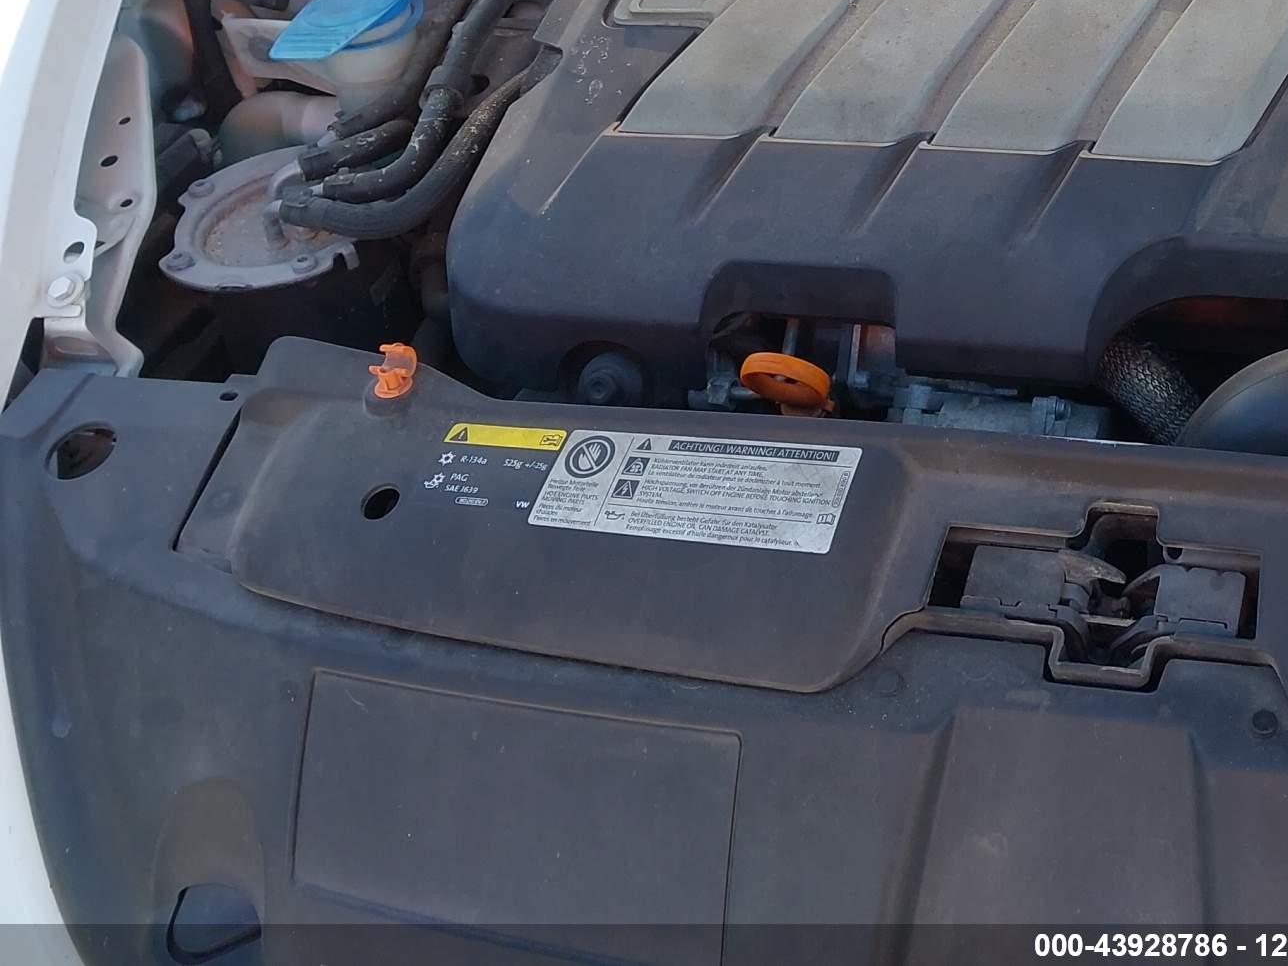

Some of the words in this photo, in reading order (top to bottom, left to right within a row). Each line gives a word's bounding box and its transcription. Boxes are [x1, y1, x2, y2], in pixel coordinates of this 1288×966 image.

[672, 442, 727, 454] ACHTUNG!
[727, 446, 777, 457] WARNING!
[777, 449, 836, 461] ATTENTION!
[460, 455, 488, 465] R-134a
[450, 472, 469, 483] PAG
[444, 485, 461, 493] SAE
[515, 499, 530, 509] VW
